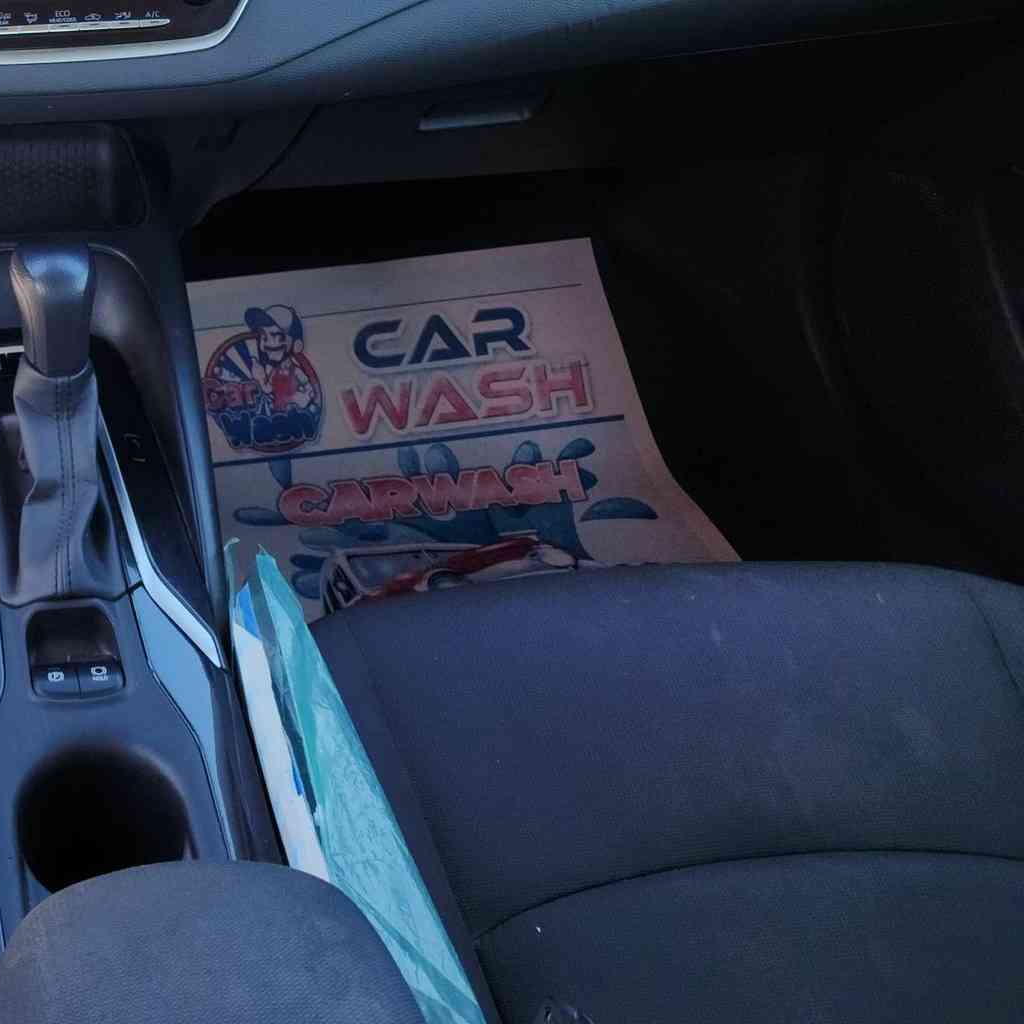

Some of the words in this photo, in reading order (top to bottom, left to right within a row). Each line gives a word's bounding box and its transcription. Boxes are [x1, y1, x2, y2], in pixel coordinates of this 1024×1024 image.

[352, 306, 531, 368] CAR
[337, 358, 593, 435] WASH
[278, 459, 589, 528] CARWASH
